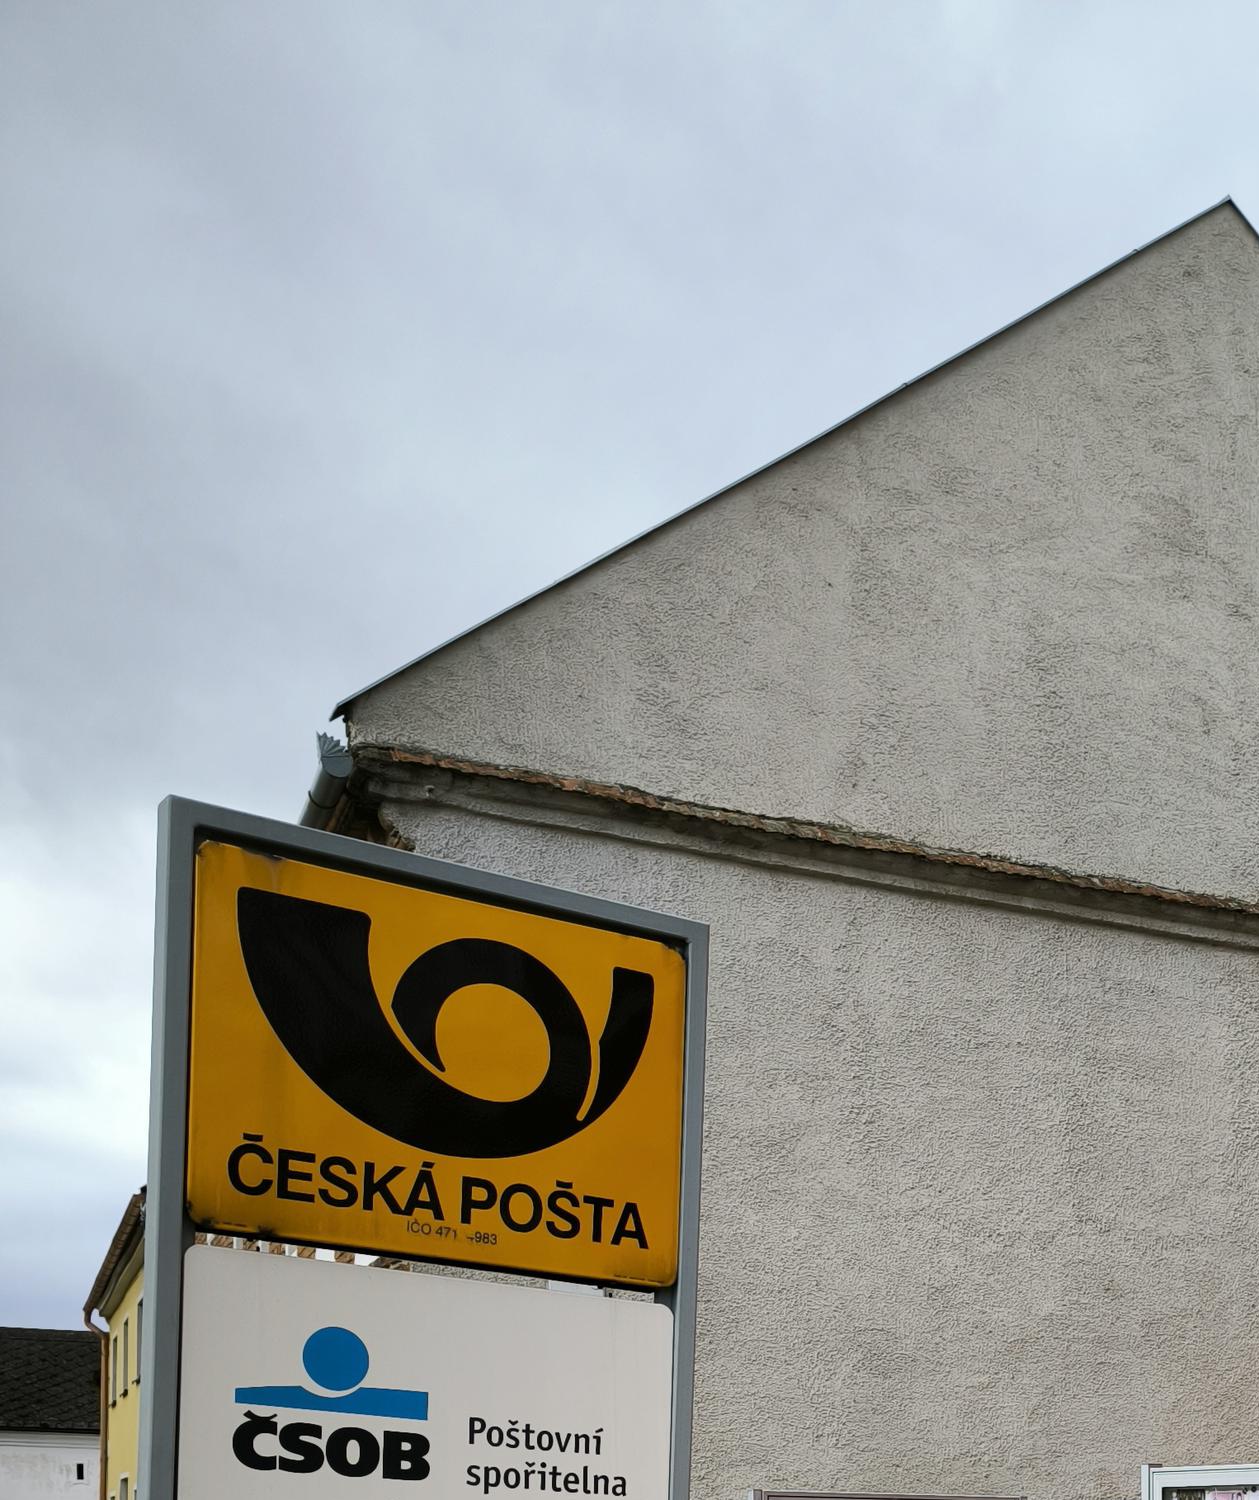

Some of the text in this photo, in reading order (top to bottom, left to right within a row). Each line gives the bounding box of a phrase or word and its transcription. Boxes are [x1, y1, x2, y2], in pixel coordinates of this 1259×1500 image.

[226, 1132, 650, 1250] ČESKÁ POŠTA
[231, 1409, 431, 1481] ČSOB
[467, 1416, 604, 1456] Poštovní
[465, 1461, 627, 1497] spořitelna
